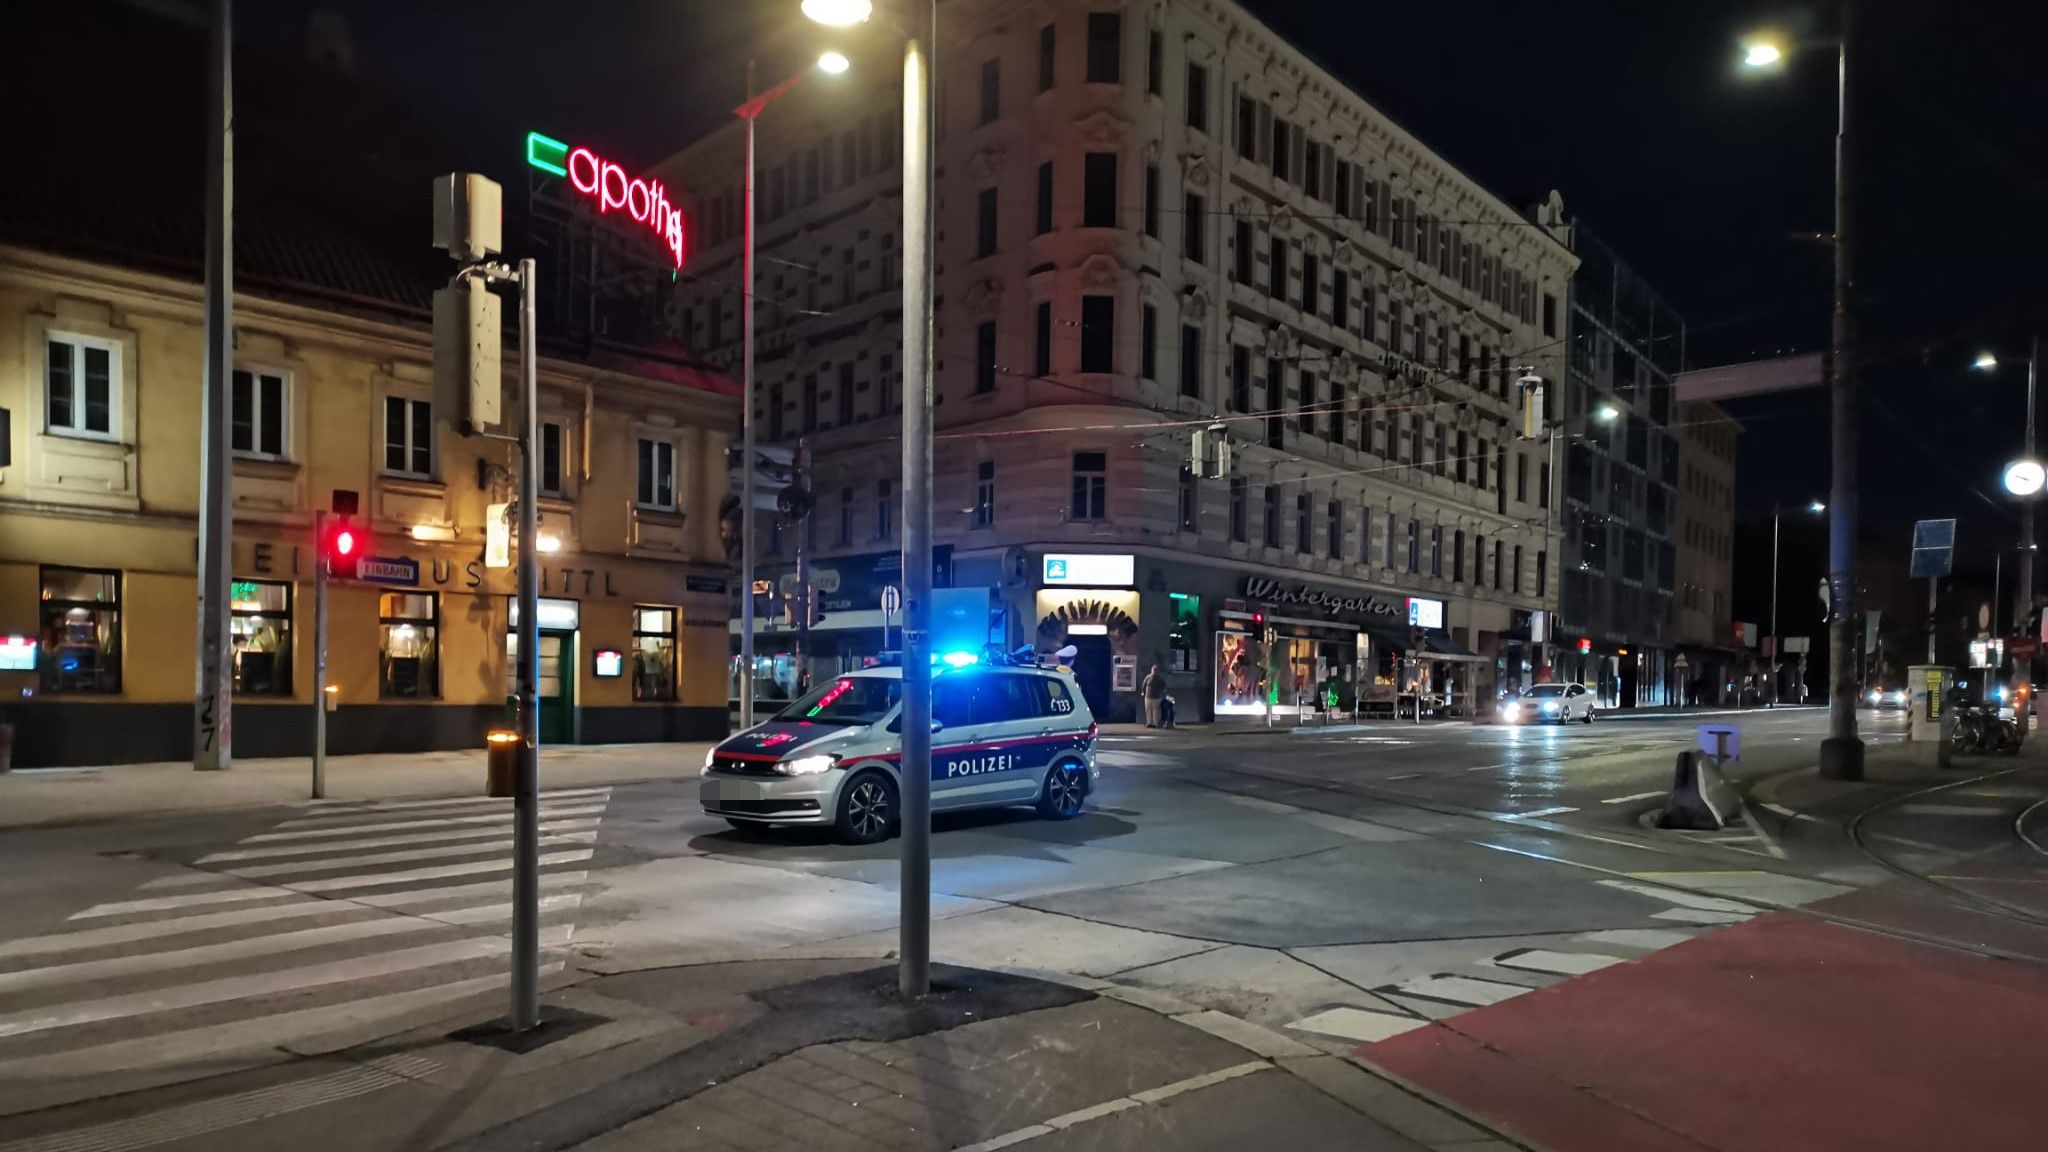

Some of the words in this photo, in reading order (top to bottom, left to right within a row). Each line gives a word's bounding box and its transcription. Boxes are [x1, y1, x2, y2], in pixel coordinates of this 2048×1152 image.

[365, 563, 411, 581] EINBAHN
[1247, 577, 1400, 615] Wintergarten
[948, 754, 1012, 777] POLIZEI
